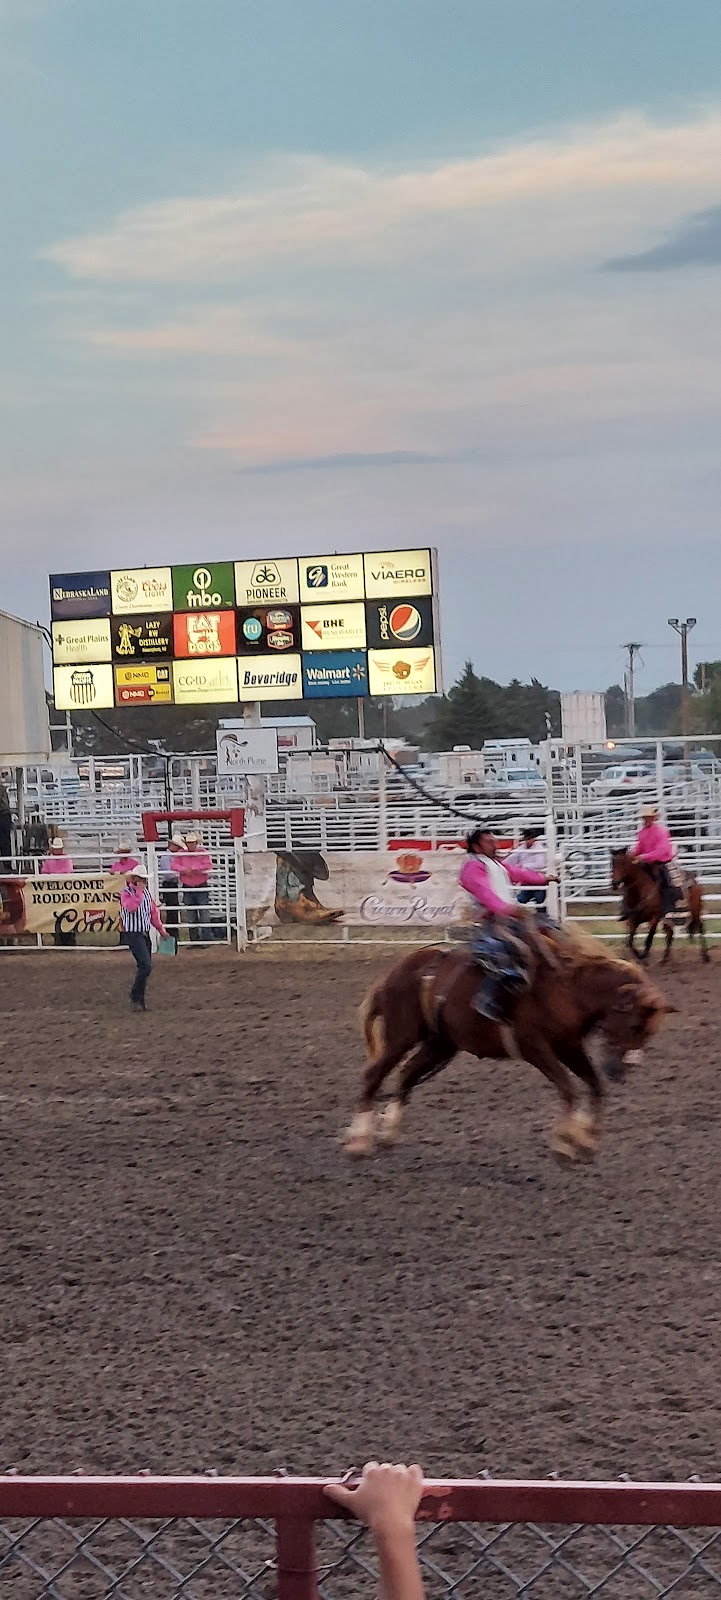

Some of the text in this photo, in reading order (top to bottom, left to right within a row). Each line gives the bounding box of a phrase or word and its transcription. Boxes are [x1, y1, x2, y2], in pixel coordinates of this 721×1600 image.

[330, 563, 350, 571] Great
[331, 571, 358, 579] Western
[331, 580, 348, 588] Bank
[186, 590, 222, 608] fnbo
[246, 587, 287, 600] PIONEER
[145, 620, 161, 629] LAZY
[187, 614, 221, 632] FAT
[243, 623, 258, 634] tru
[323, 619, 345, 628] BHE
[378, 604, 390, 640] pepsi
[66, 634, 109, 644] Great Plains
[138, 637, 169, 647] DISTILLERY
[65, 645, 88, 653] Health
[188, 640, 222, 655] DOGS
[243, 670, 298, 686] Beveridge
[306, 666, 351, 680] Walmart
[31, 879, 105, 892] WELCOME
[32, 891, 121, 905] RODEO FANS
[360, 895, 462, 922] Crown Royal
[53, 908, 120, 933] Coor
